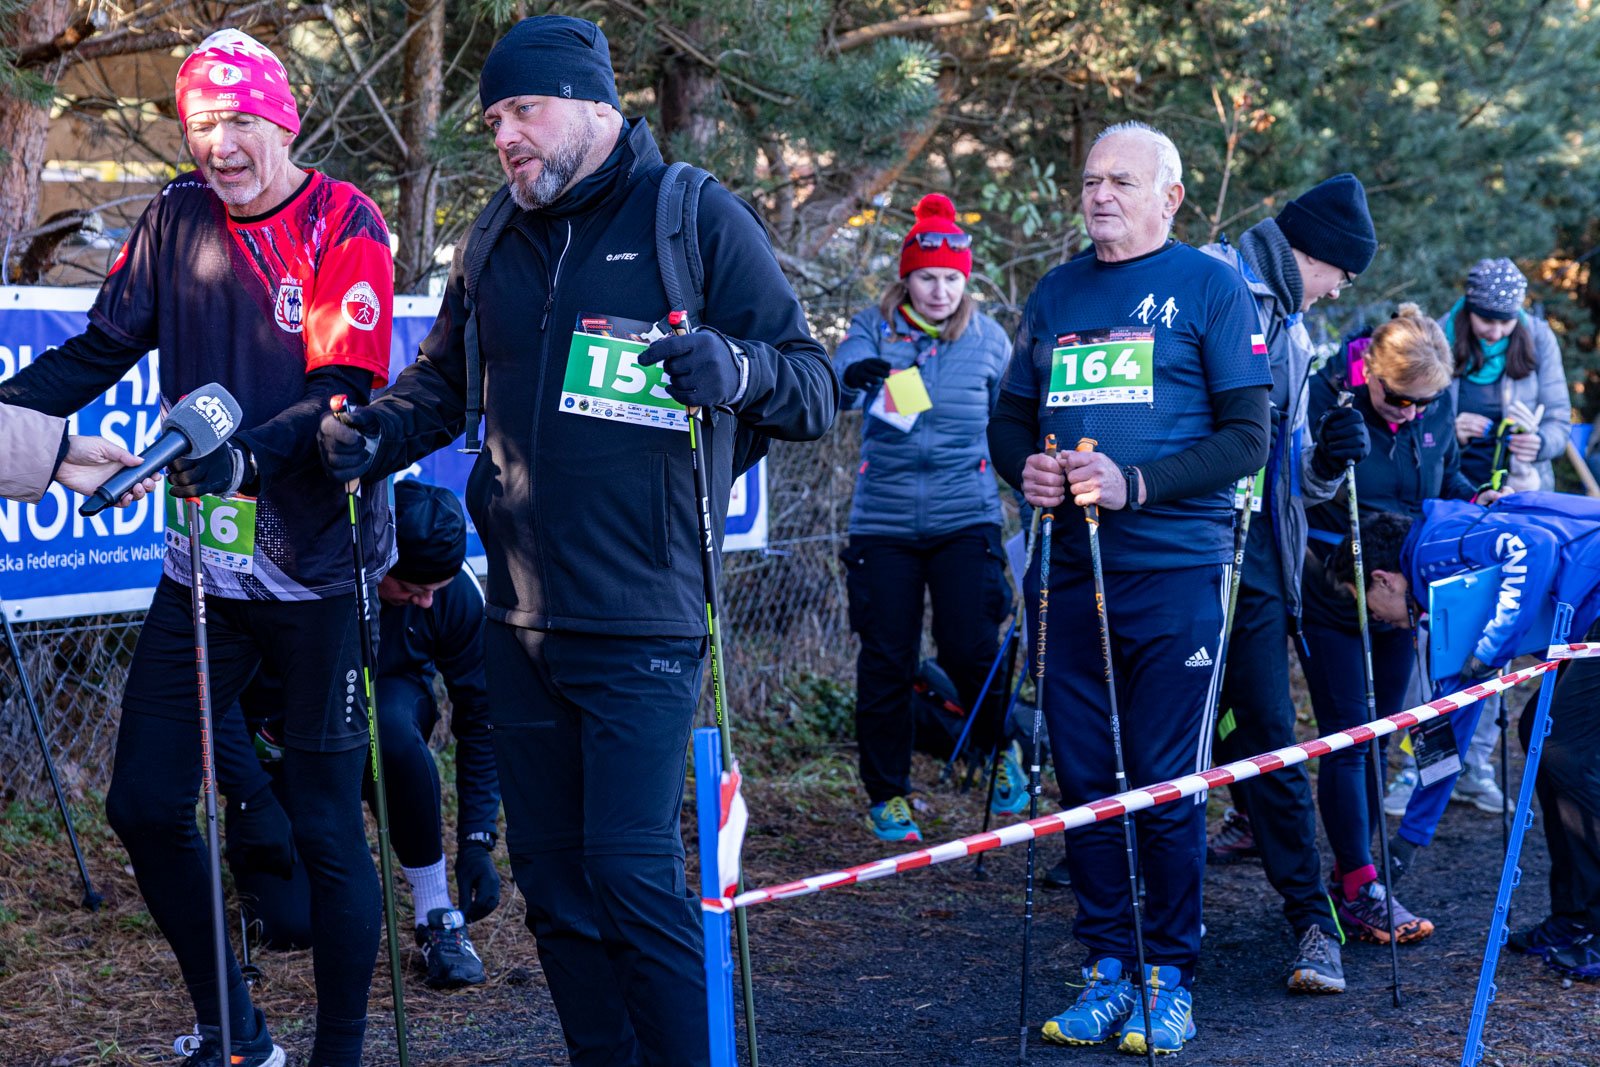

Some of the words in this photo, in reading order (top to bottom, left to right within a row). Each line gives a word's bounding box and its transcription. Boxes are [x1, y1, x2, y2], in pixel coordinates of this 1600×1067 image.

[1062, 348, 1141, 386] 164
[189, 404, 212, 424] JELENIA
[702, 496, 714, 553] LEKI
[26, 548, 86, 570] Federacja
[88, 545, 129, 566] Nordic
[196, 572, 207, 625] LEKI
[361, 566, 371, 621] LEKI
[195, 647, 208, 711] FLASH
[650, 658, 682, 674] FILA
[710, 645, 719, 681] FLASH
[1184, 659, 1213, 668] adidas
[713, 682, 723, 725] CARBON
[367, 706, 375, 741] FLASH
